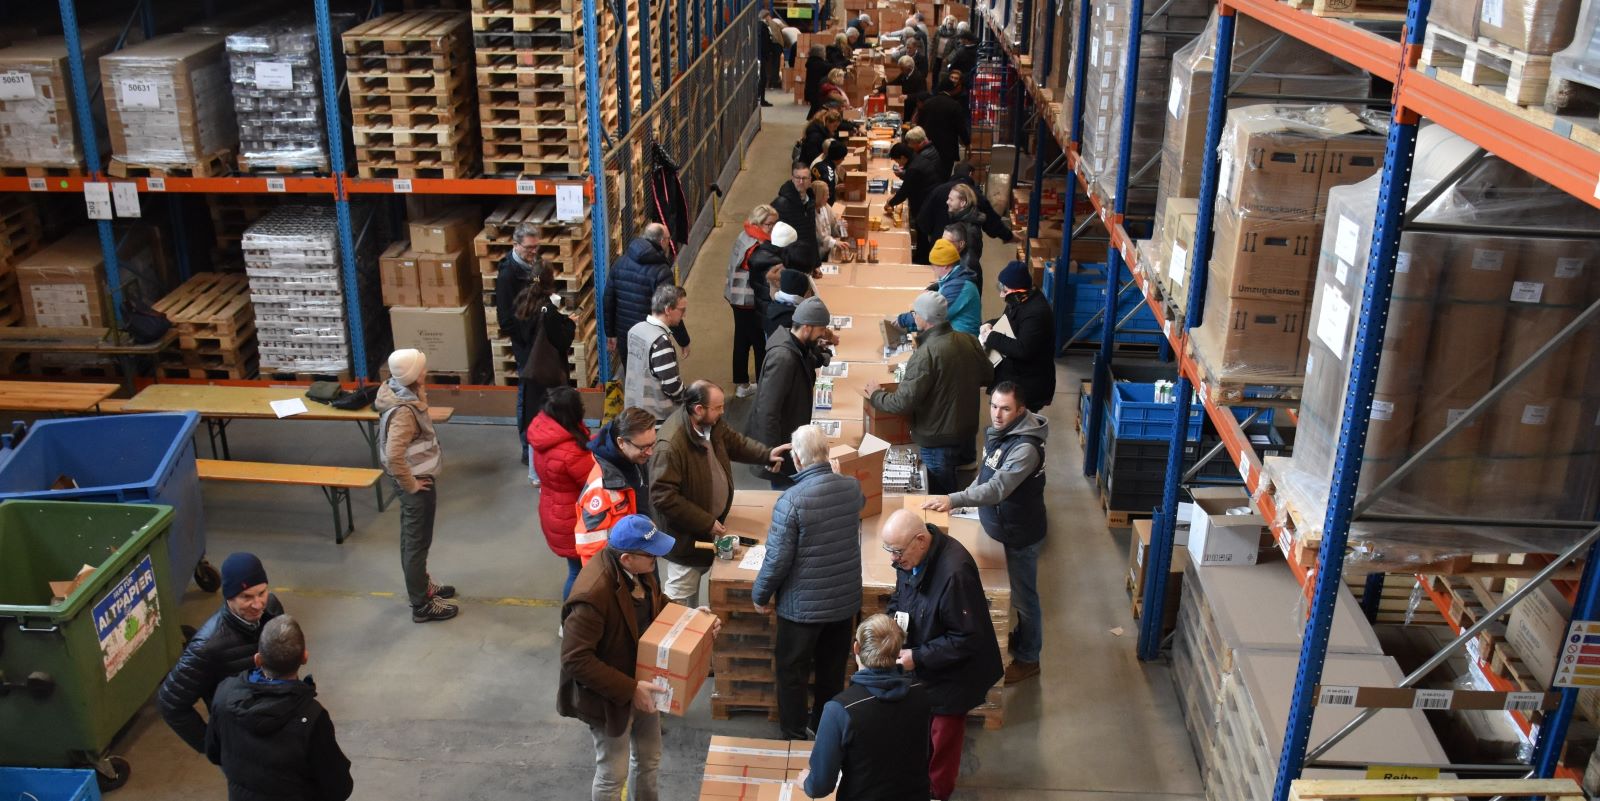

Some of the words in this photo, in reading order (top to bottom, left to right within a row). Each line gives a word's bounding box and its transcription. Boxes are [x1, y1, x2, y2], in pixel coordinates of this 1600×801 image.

[2, 76, 25, 84] 50631
[128, 84, 151, 92] 50631
[1238, 284, 1301, 297] Umzugskarton
[123, 576, 134, 591] FÜR
[99, 569, 153, 631] ALTPAPIER
